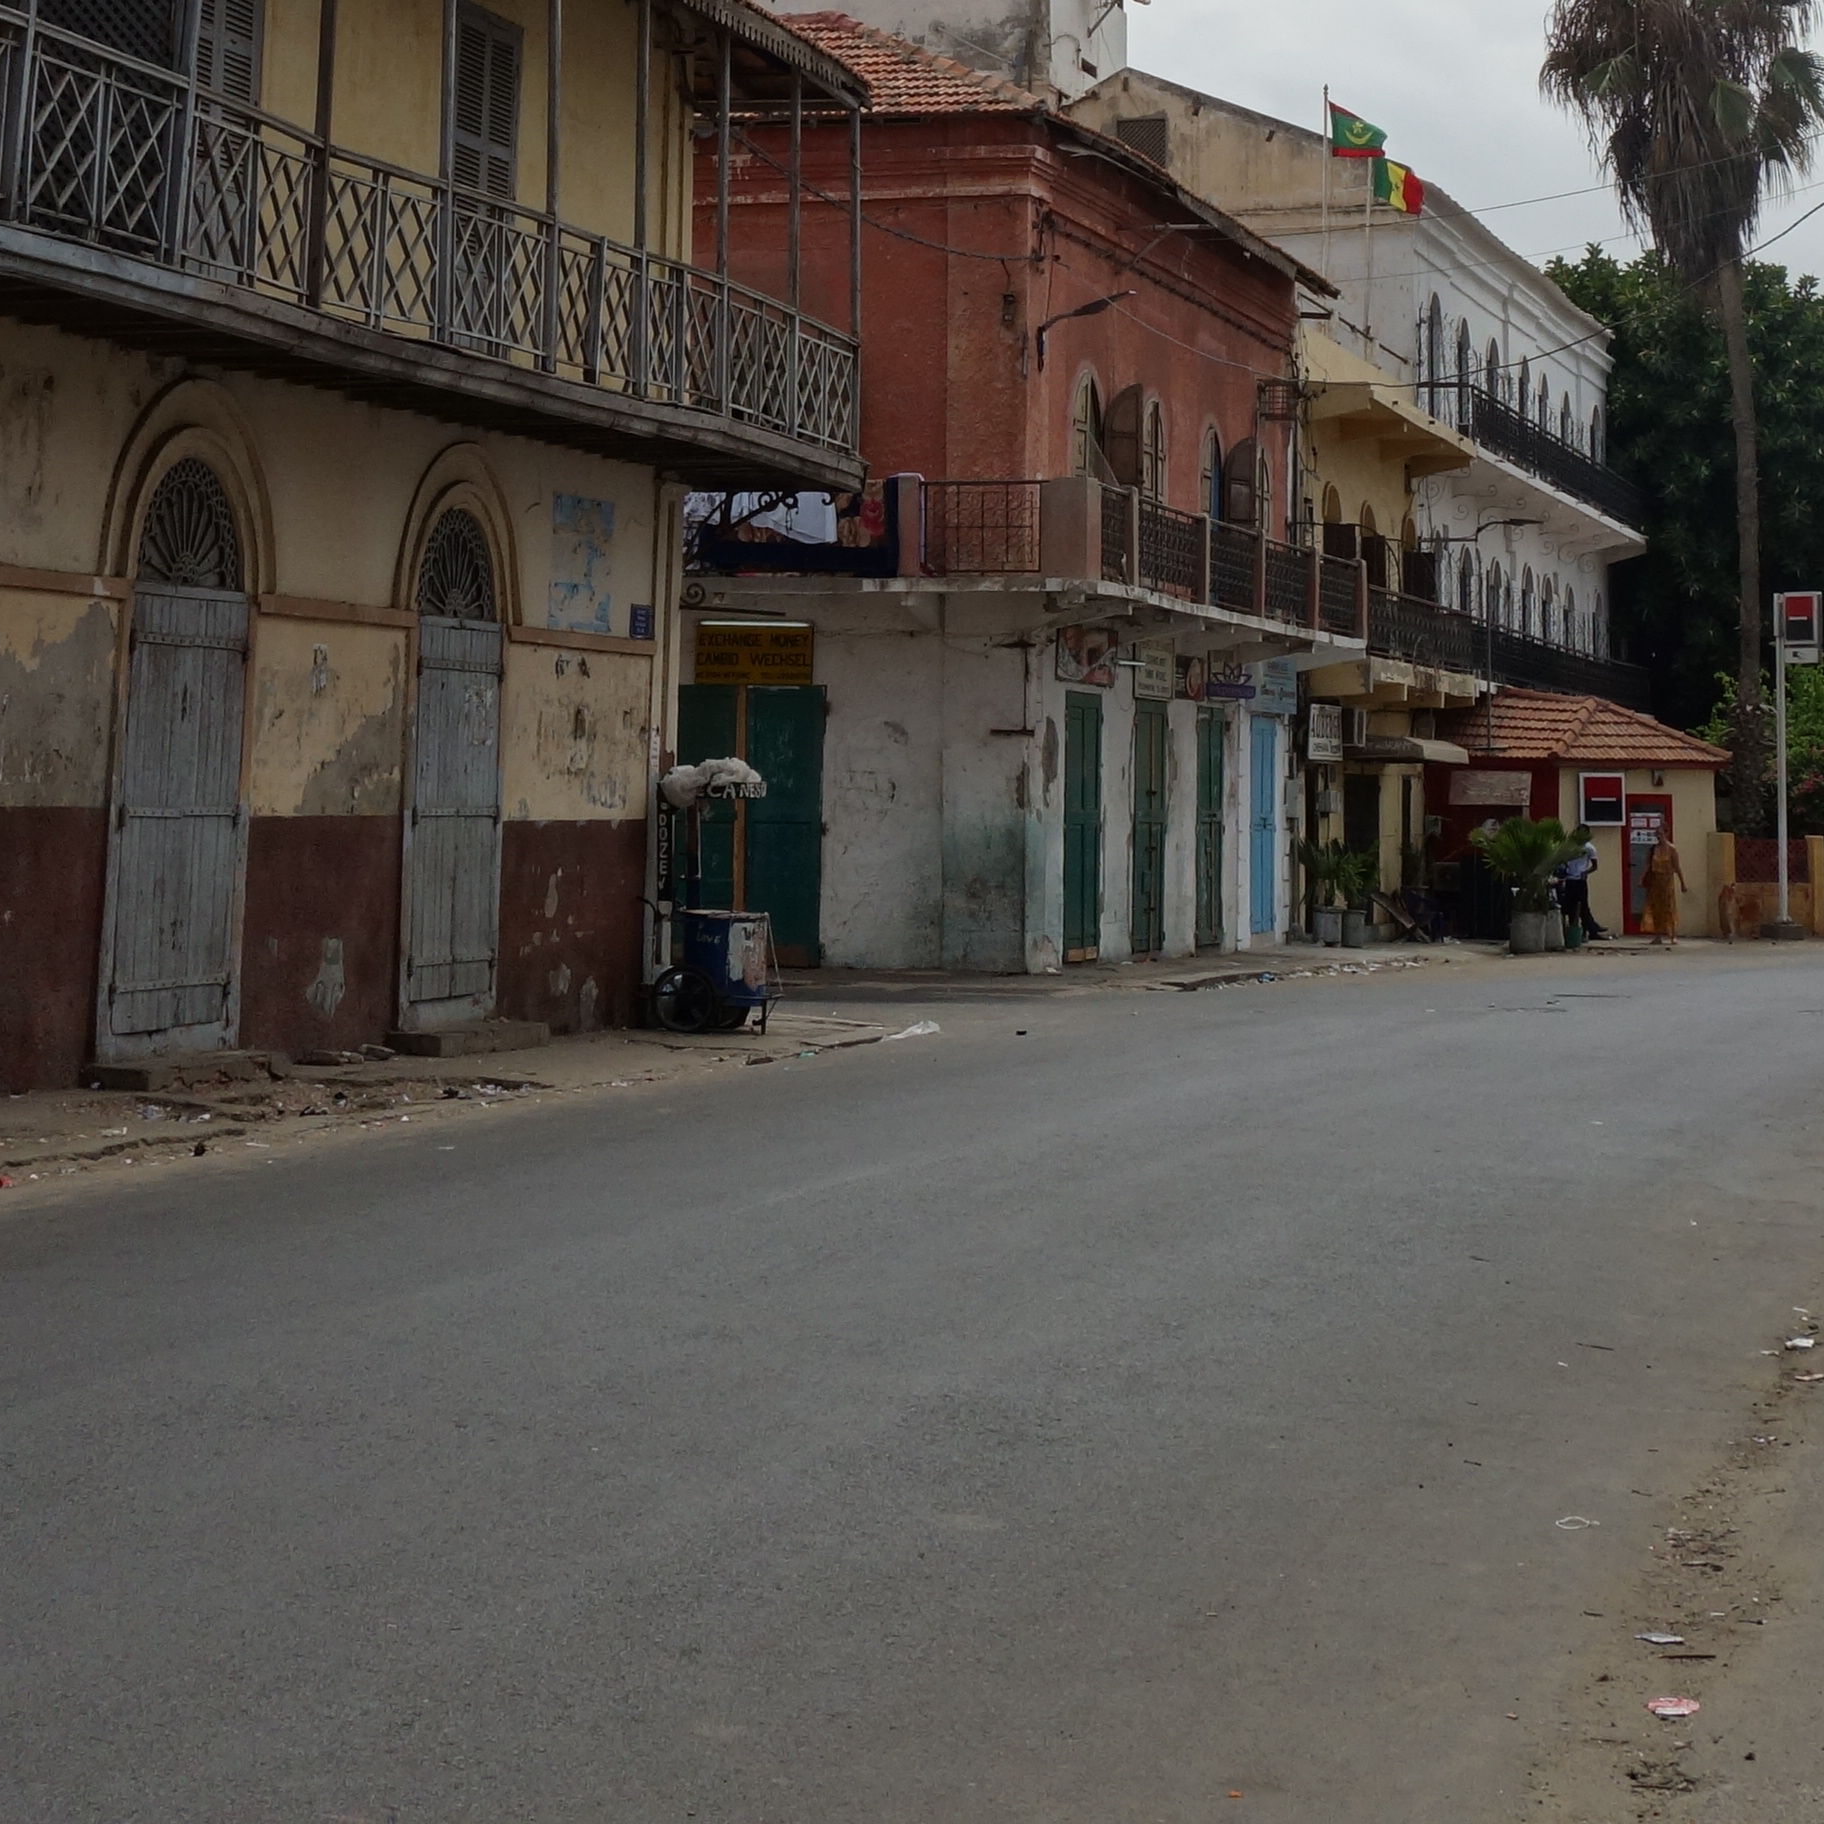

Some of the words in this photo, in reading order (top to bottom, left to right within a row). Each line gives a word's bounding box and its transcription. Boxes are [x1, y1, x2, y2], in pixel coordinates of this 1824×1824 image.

[698, 633, 763, 647] EXCHANGE
[769, 633, 810, 648] MONEY
[749, 652, 811, 667] WECHSEL
